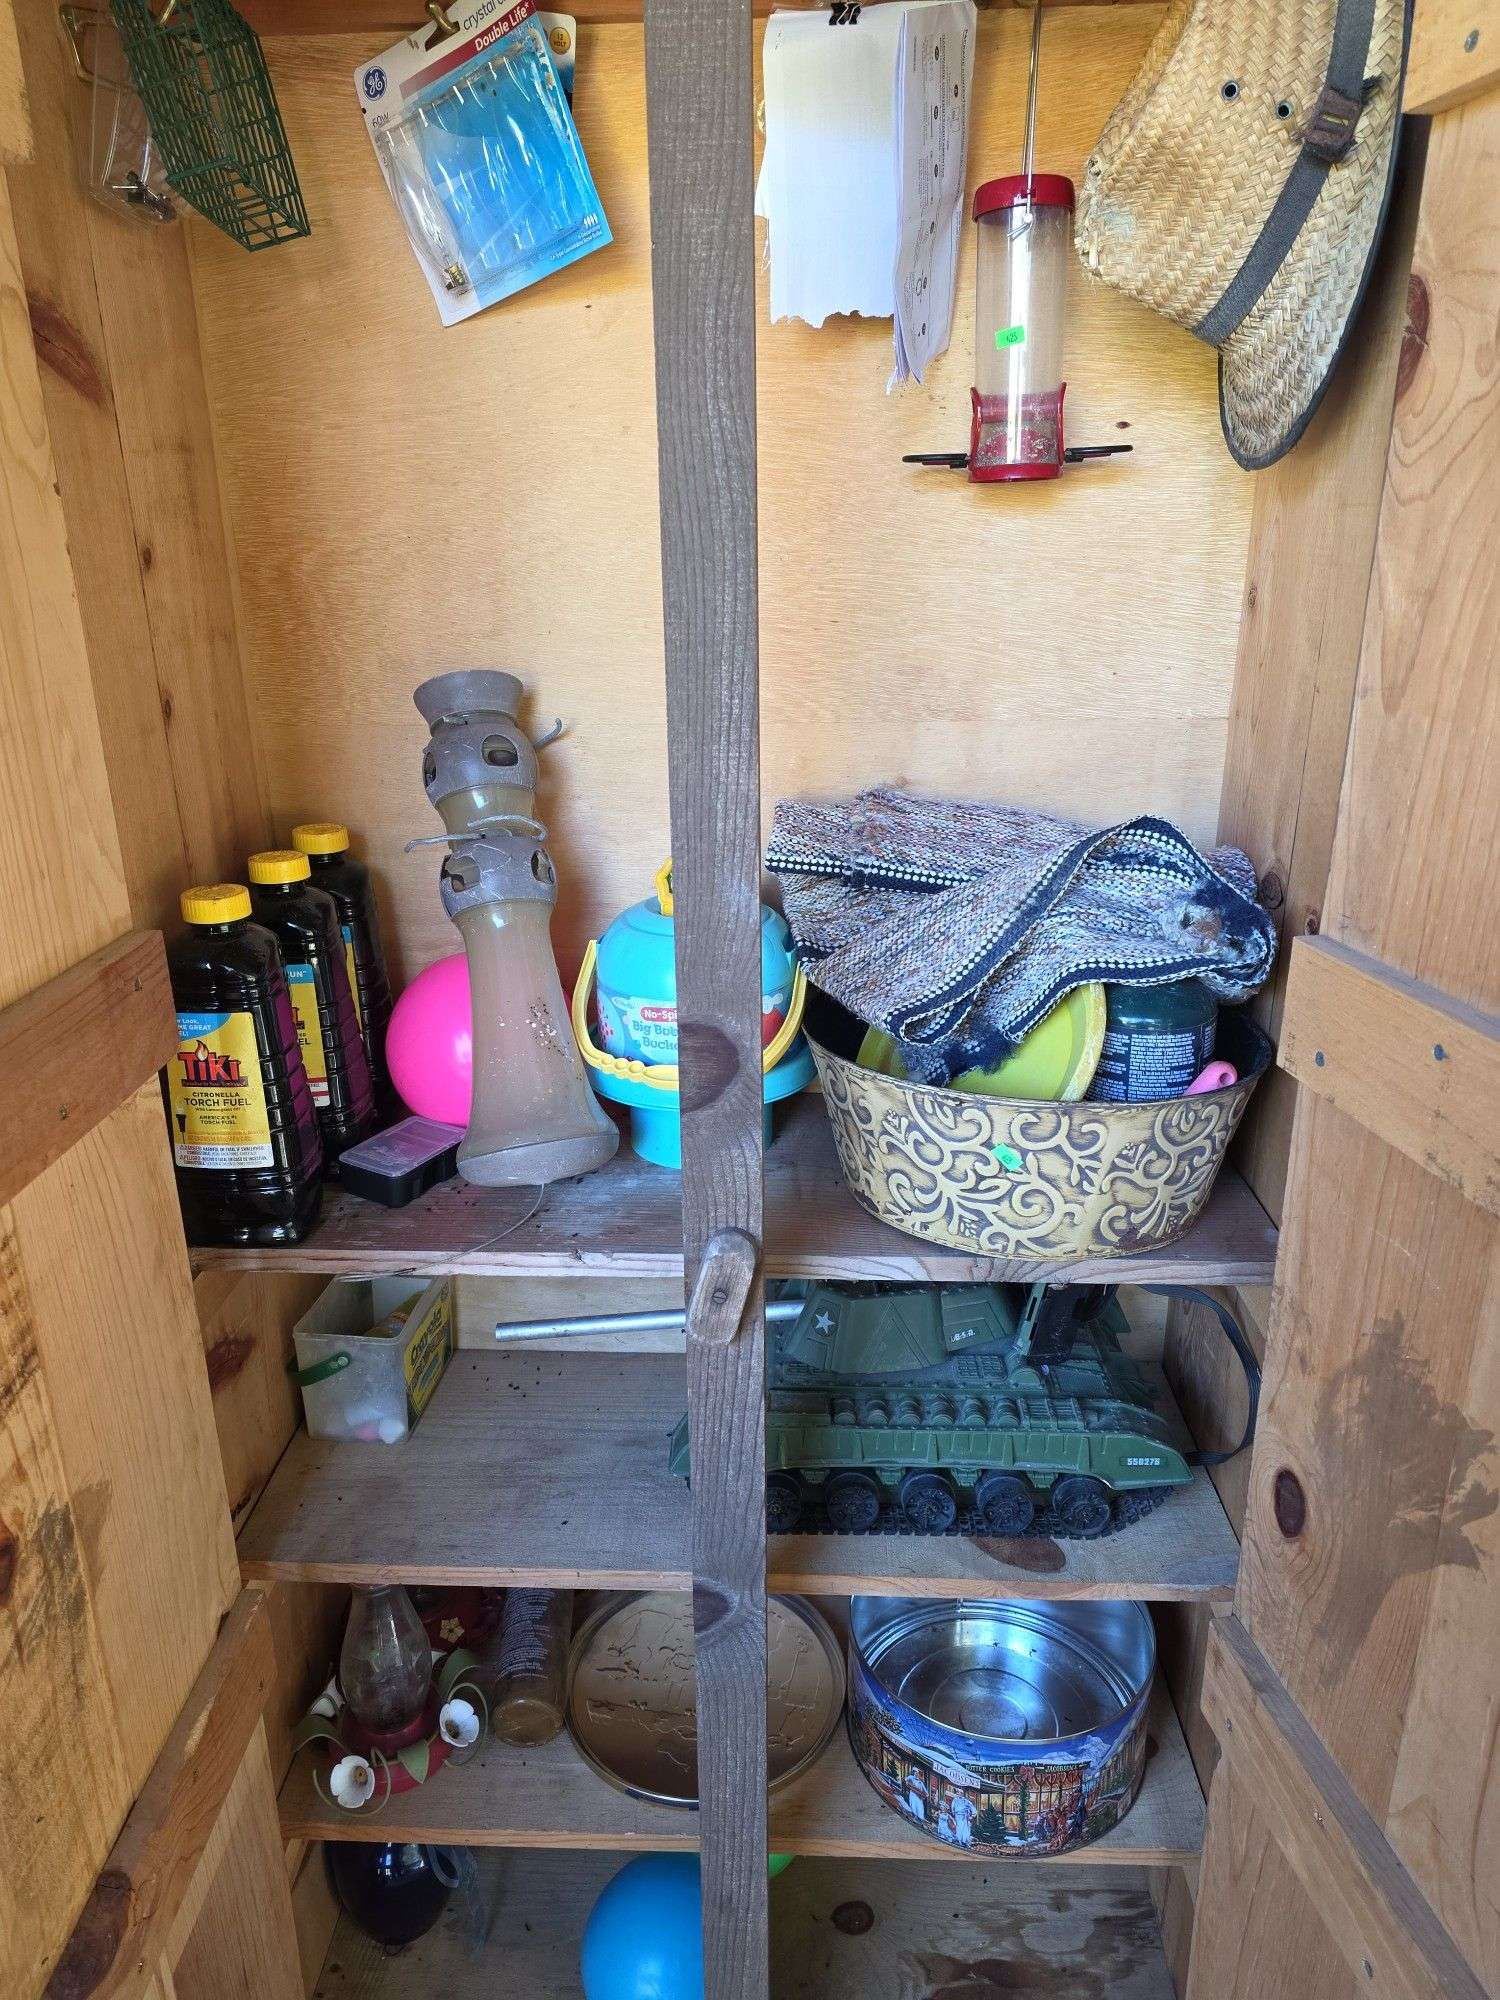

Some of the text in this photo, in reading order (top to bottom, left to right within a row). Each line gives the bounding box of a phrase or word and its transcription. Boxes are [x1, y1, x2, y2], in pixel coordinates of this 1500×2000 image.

[474, 22, 510, 51] Double
[644, 1010, 678, 1021] No-Spi
[632, 1021, 651, 1036] Big
[642, 1036, 678, 1050] Buck
[184, 1098, 252, 1107] TORCH FUEL
[989, 1765, 1015, 1773] COOKIES
